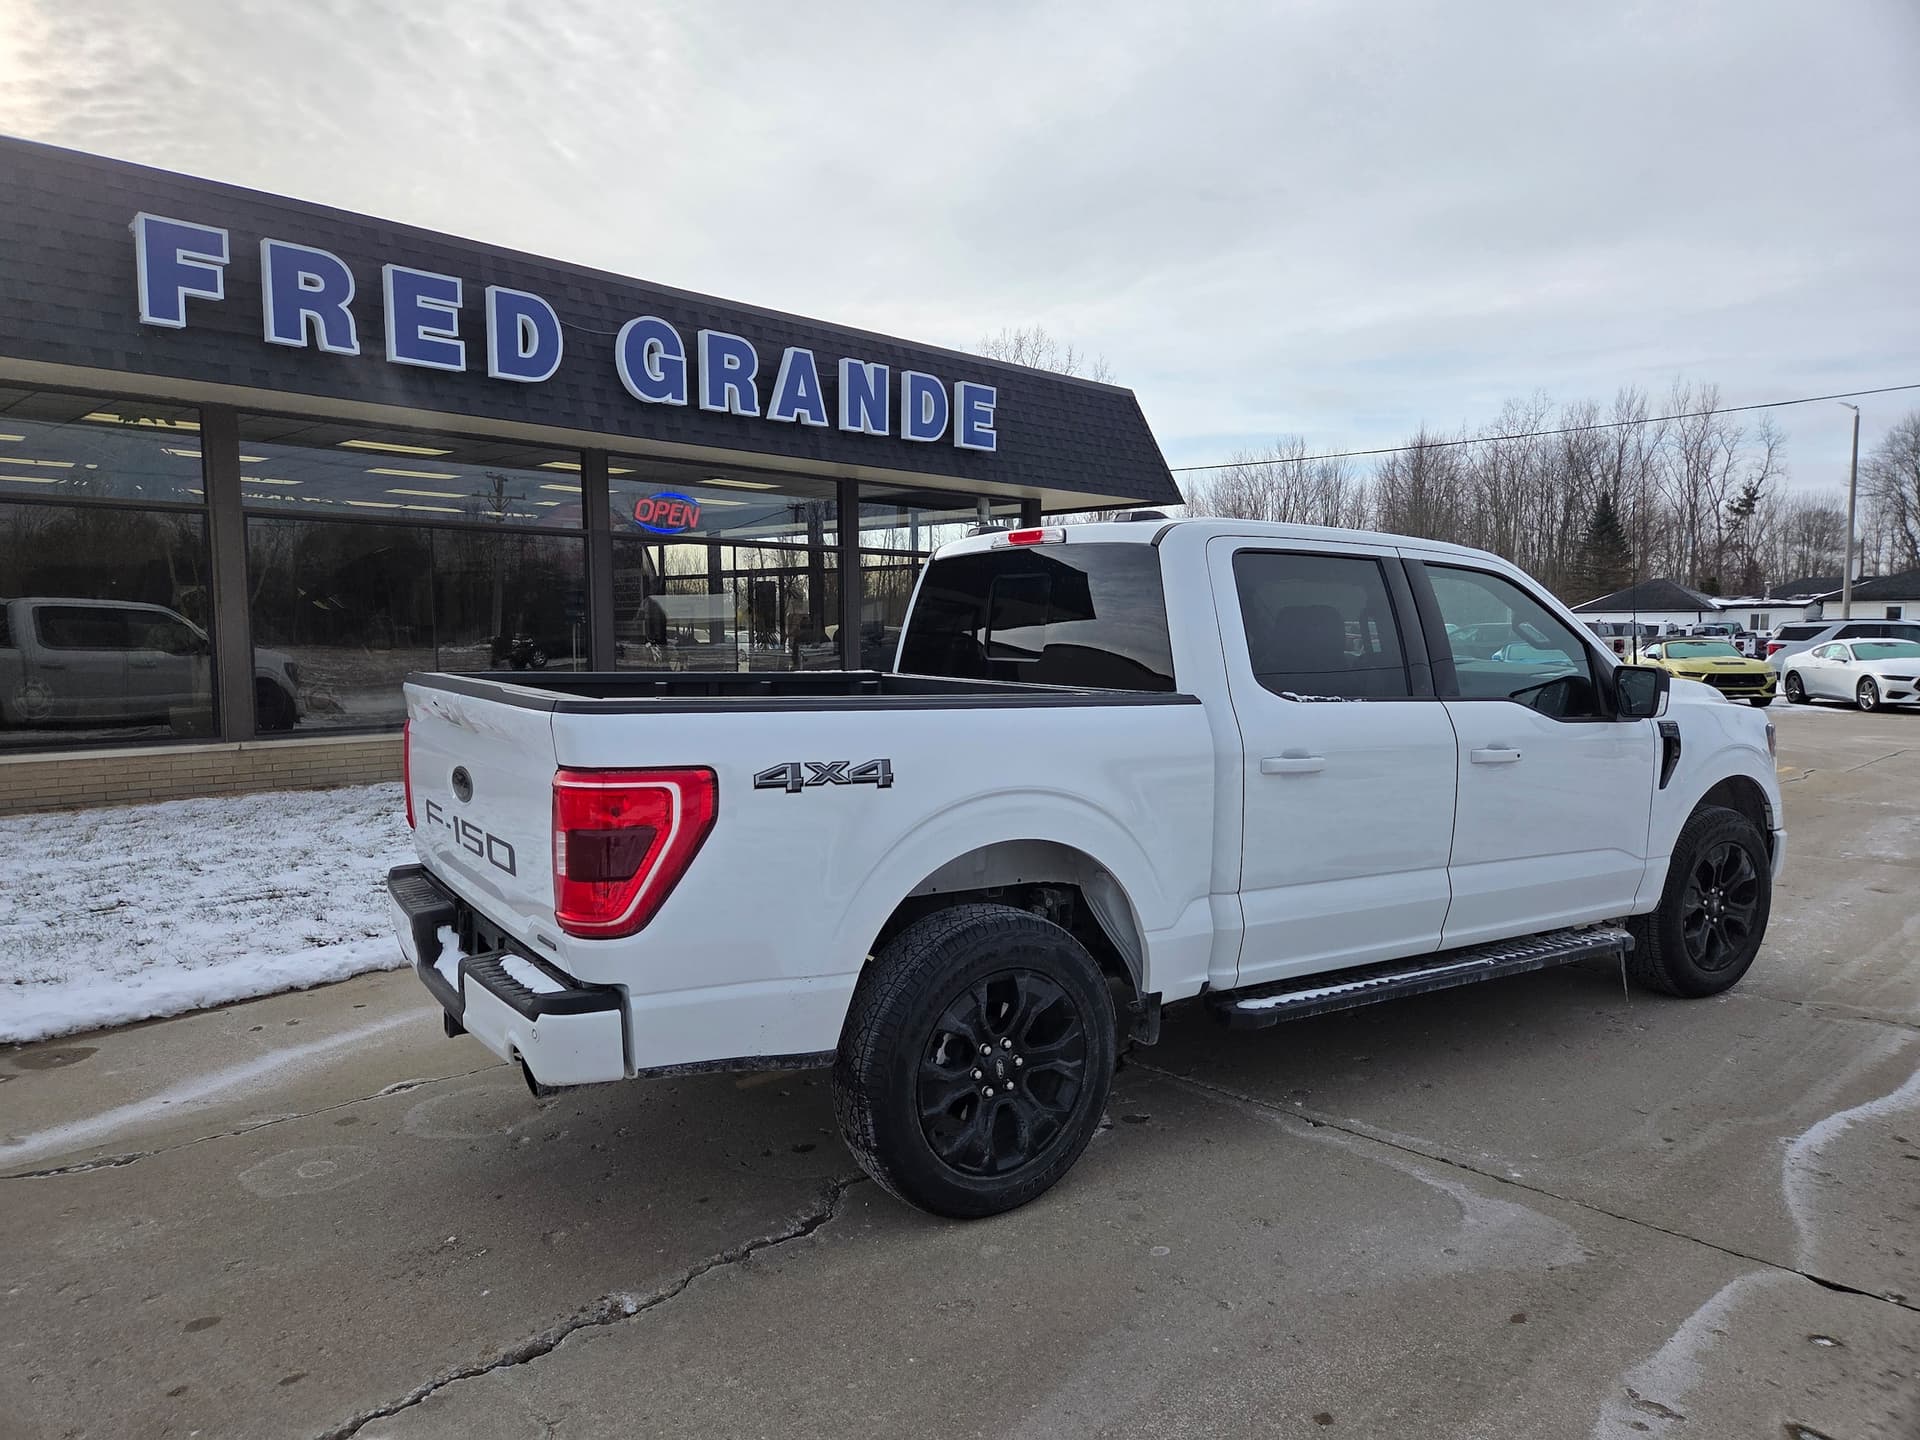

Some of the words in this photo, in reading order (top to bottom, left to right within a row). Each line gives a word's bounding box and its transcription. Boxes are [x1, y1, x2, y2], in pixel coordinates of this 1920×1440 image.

[135, 211, 563, 383] FRED
[615, 315, 997, 452] GRANDE
[634, 498, 701, 528] OPEN
[426, 799, 516, 877] F-150
